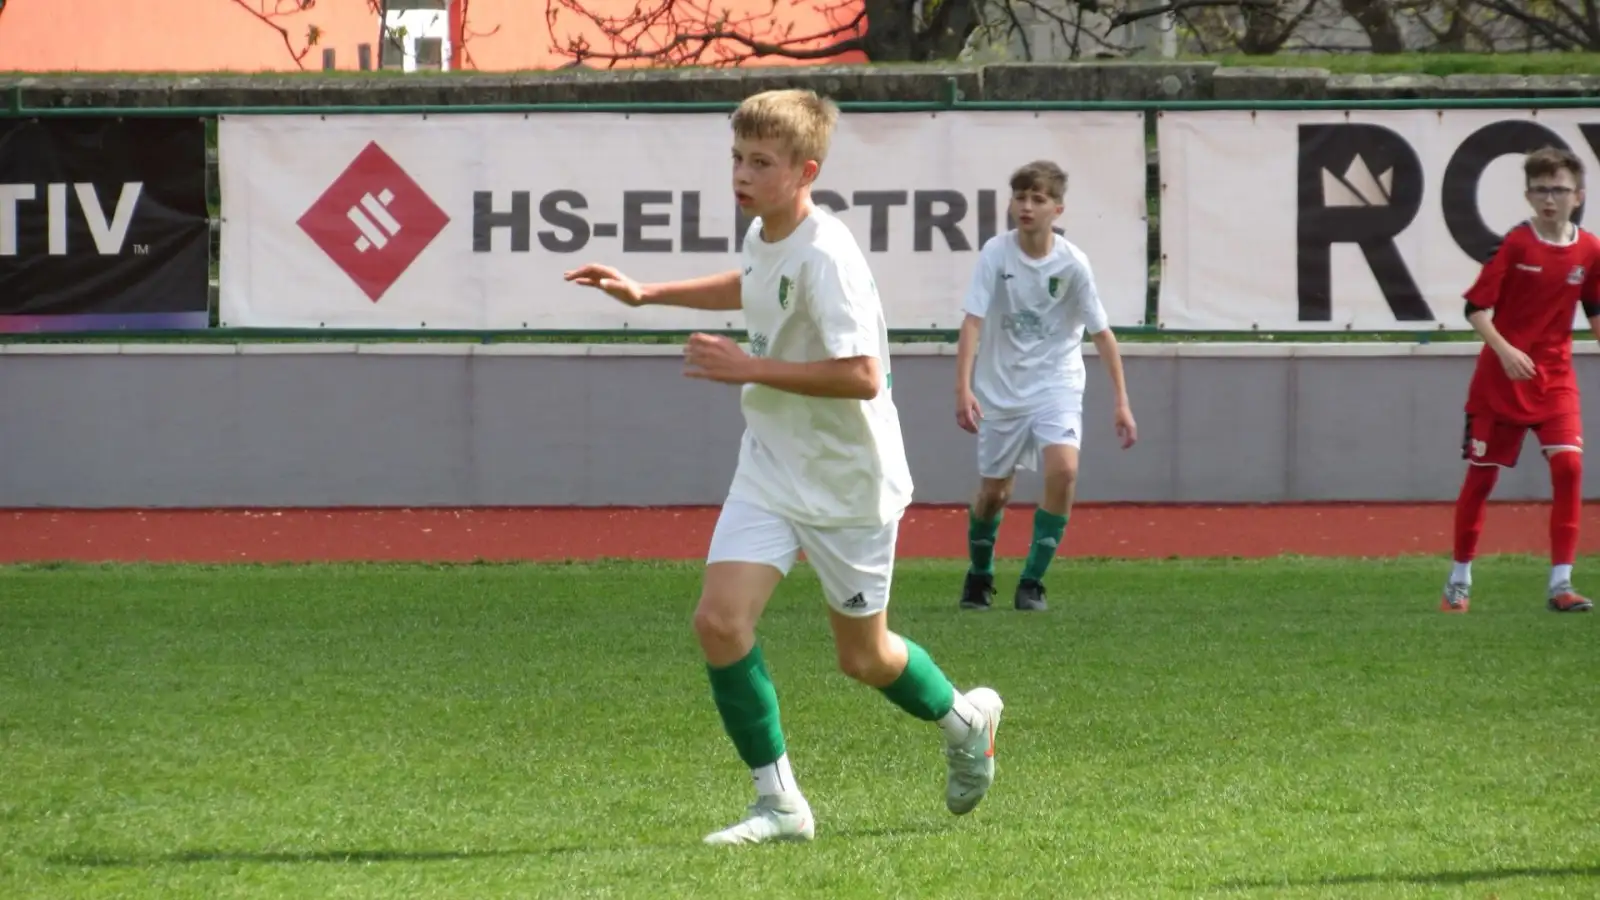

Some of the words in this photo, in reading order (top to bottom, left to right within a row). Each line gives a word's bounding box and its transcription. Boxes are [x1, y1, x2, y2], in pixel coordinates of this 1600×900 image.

[133, 244, 149, 255] TM
[473, 189, 1065, 253] HS-ELTRI
[1297, 120, 1600, 321] RO
